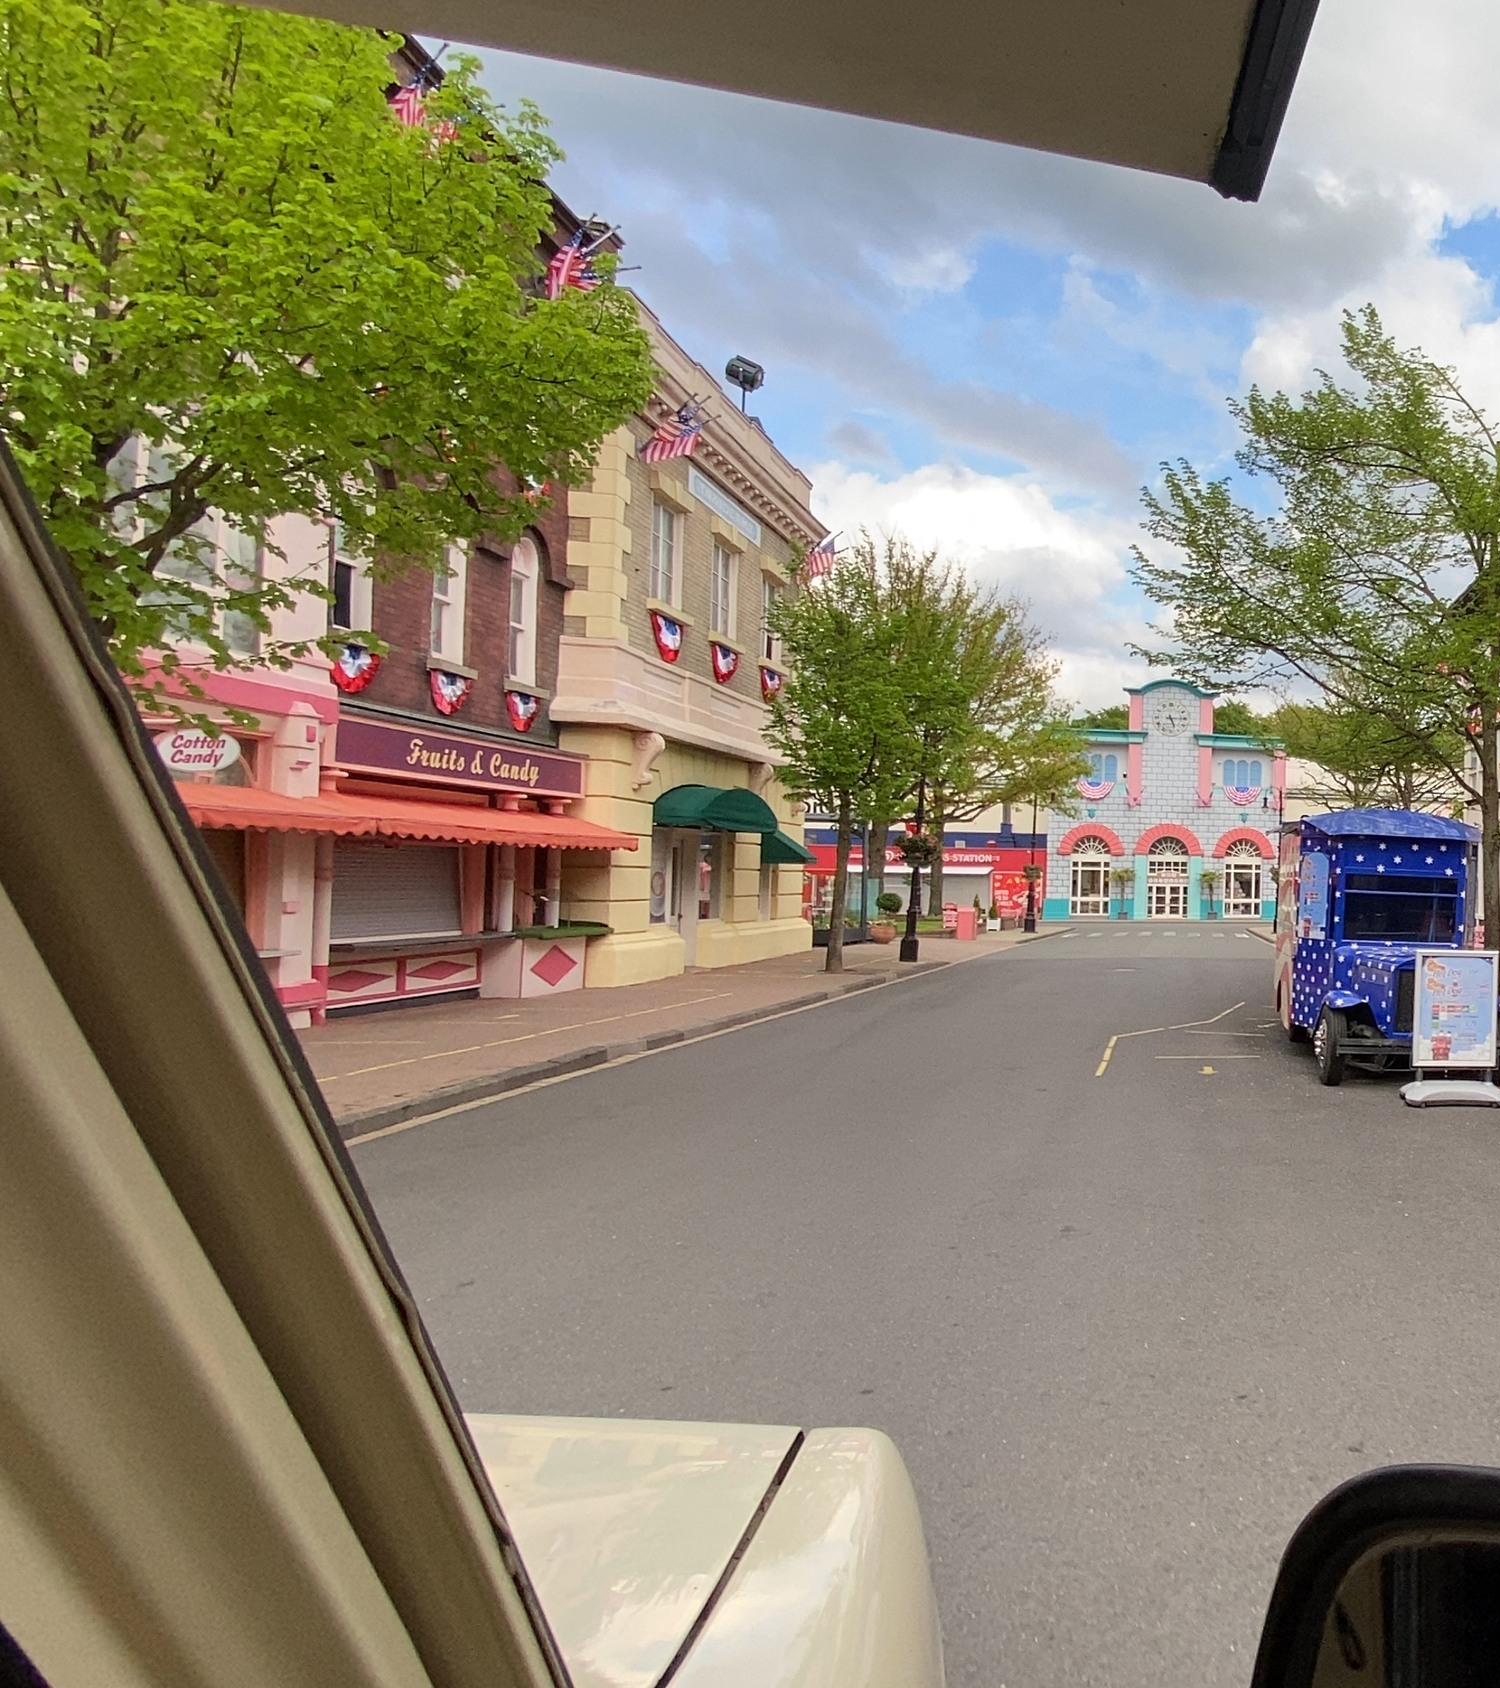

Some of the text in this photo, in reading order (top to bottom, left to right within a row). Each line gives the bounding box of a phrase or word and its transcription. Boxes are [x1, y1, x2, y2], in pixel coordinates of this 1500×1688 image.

[171, 734, 226, 749] Cotton
[170, 749, 224, 768] Candy
[406, 738, 540, 787] Fruits & Candy
[952, 853, 993, 863] STATION
